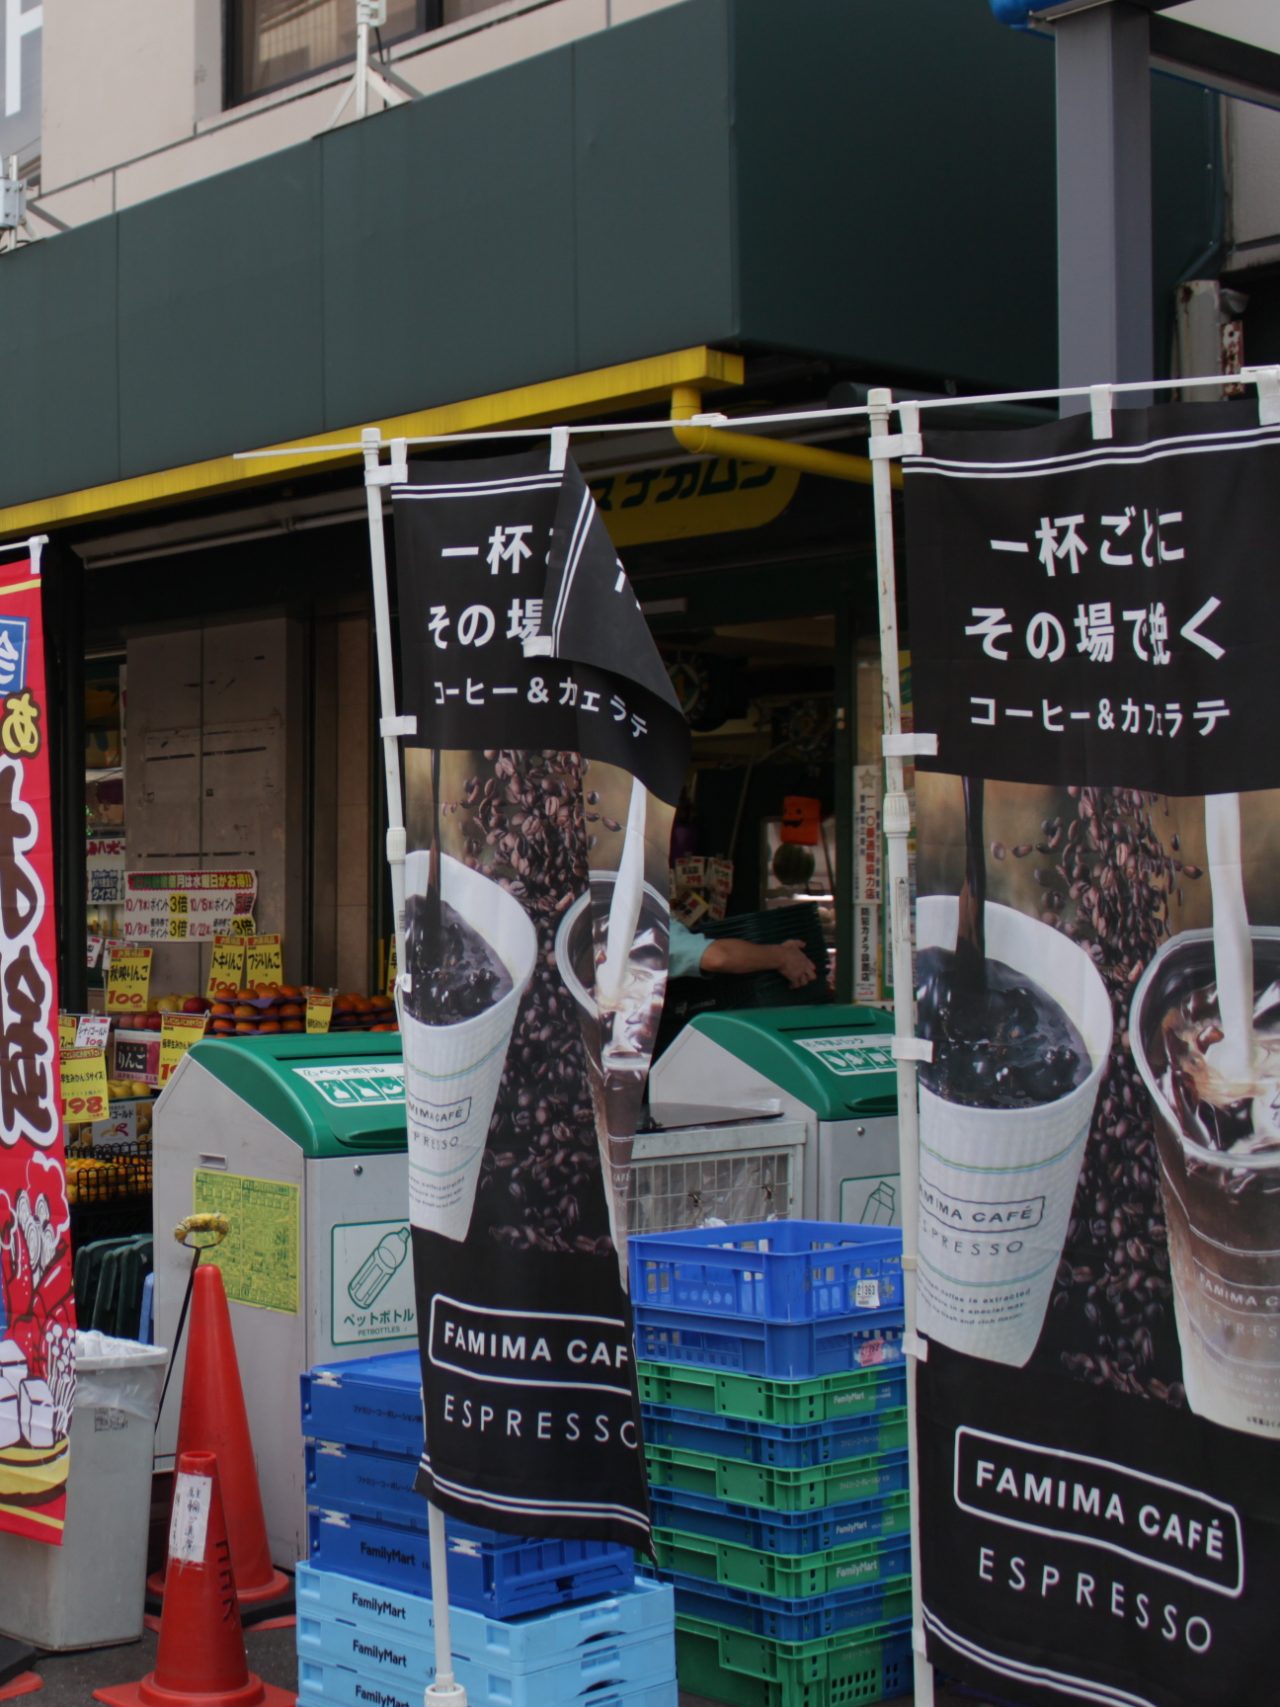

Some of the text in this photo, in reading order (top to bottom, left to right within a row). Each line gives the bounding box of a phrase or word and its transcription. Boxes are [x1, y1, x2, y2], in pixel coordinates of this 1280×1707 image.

[441, 524, 552, 576] 一杯
[990, 507, 1186, 578] 一杯ごとに
[965, 596, 1227, 666] その場で挽く
[107, 990, 144, 1005] 100
[118, 1053, 145, 1070] りんご
[972, 1205, 1033, 1223] CAFÉ
[344, 1308, 414, 1327] ペットボトル
[444, 1321, 628, 1369] FAMIMA CAF
[444, 1394, 638, 1449] ESPRESSO
[976, 1459, 1224, 1561] FAMIMA CAFÉ
[360, 1541, 416, 1568] FamilyMart
[836, 1560, 878, 1578] FamilyMart
[352, 1591, 407, 1620] FamilyMart
[978, 1546, 1213, 1654] ESPRESSO
[353, 1639, 407, 1668] FamilyMart
